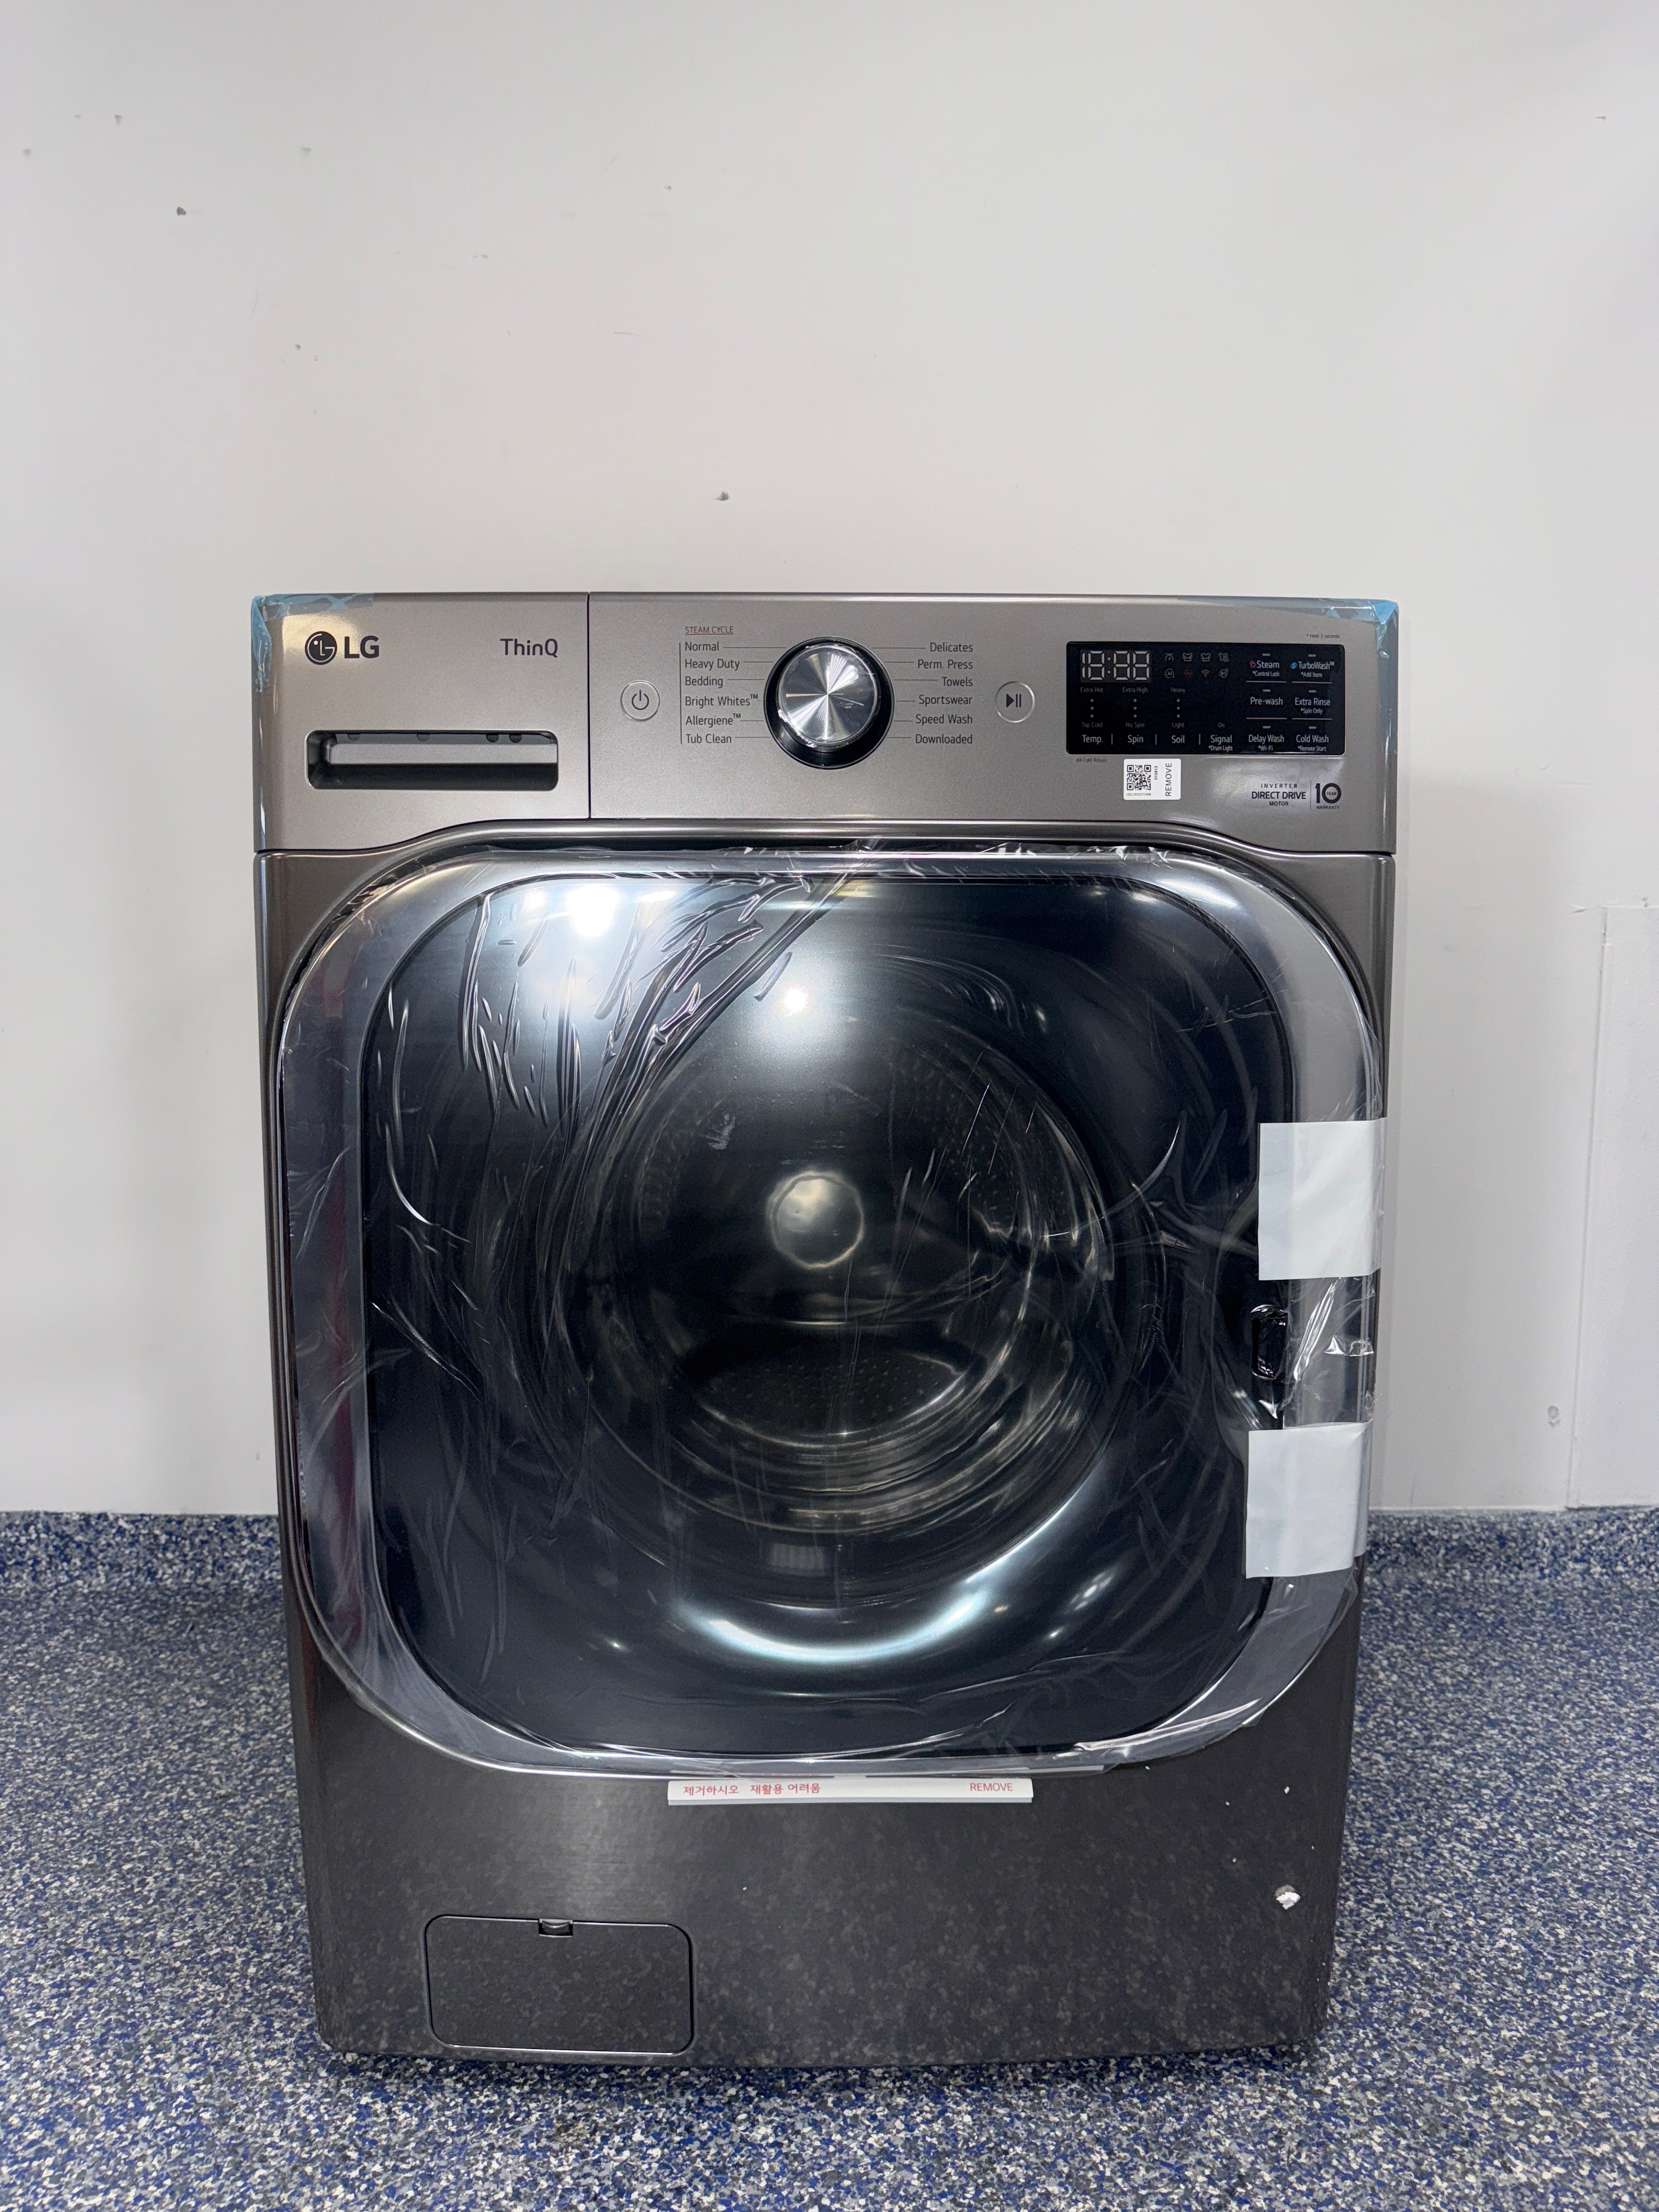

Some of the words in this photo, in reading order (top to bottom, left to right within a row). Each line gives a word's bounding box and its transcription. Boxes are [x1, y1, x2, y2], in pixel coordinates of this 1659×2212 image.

[344, 635, 380, 658] LG
[500, 639, 558, 657] ThinQ
[685, 641, 720, 651] Normal
[930, 642, 973, 652] Delicates
[685, 659, 714, 671] Heavy
[717, 659, 740, 671] Duty
[918, 659, 944, 669] Perm.
[947, 659, 973, 669] Press
[1256, 660, 1280, 669] Steam
[685, 676, 723, 689] Bedding
[941, 676, 973, 686] Towels
[685, 696, 714, 709] Bright
[919, 694, 973, 707] Sportswear
[1250, 697, 1283, 705] Pre-wash
[1295, 698, 1312, 706] Extra
[1313, 698, 1330, 706] Rinse
[916, 714, 944, 726] Speed
[947, 714, 973, 724] Wash
[685, 733, 702, 744] Tub
[706, 733, 732, 744] Clean
[916, 733, 973, 744] Downloaded
[1082, 735, 1103, 745] Temp.
[1127, 735, 1144, 744] Spin
[1171, 735, 1185, 743] Soil
[1210, 735, 1232, 745] Signal
[1248, 734, 1266, 744] Delay
[1267, 734, 1284, 743] Wash
[1296, 734, 1310, 743] Cold
[1312, 735, 1329, 743] Wash
[1251, 791, 1280, 799] DIRECT
[1315, 783, 1342, 804] 10
[683, 1785, 740, 1796] 제거하시오
[750, 1784, 783, 1795] 재활용
[787, 1782, 821, 1794] 어려움
[970, 1782, 1013, 1792] REMOVE
